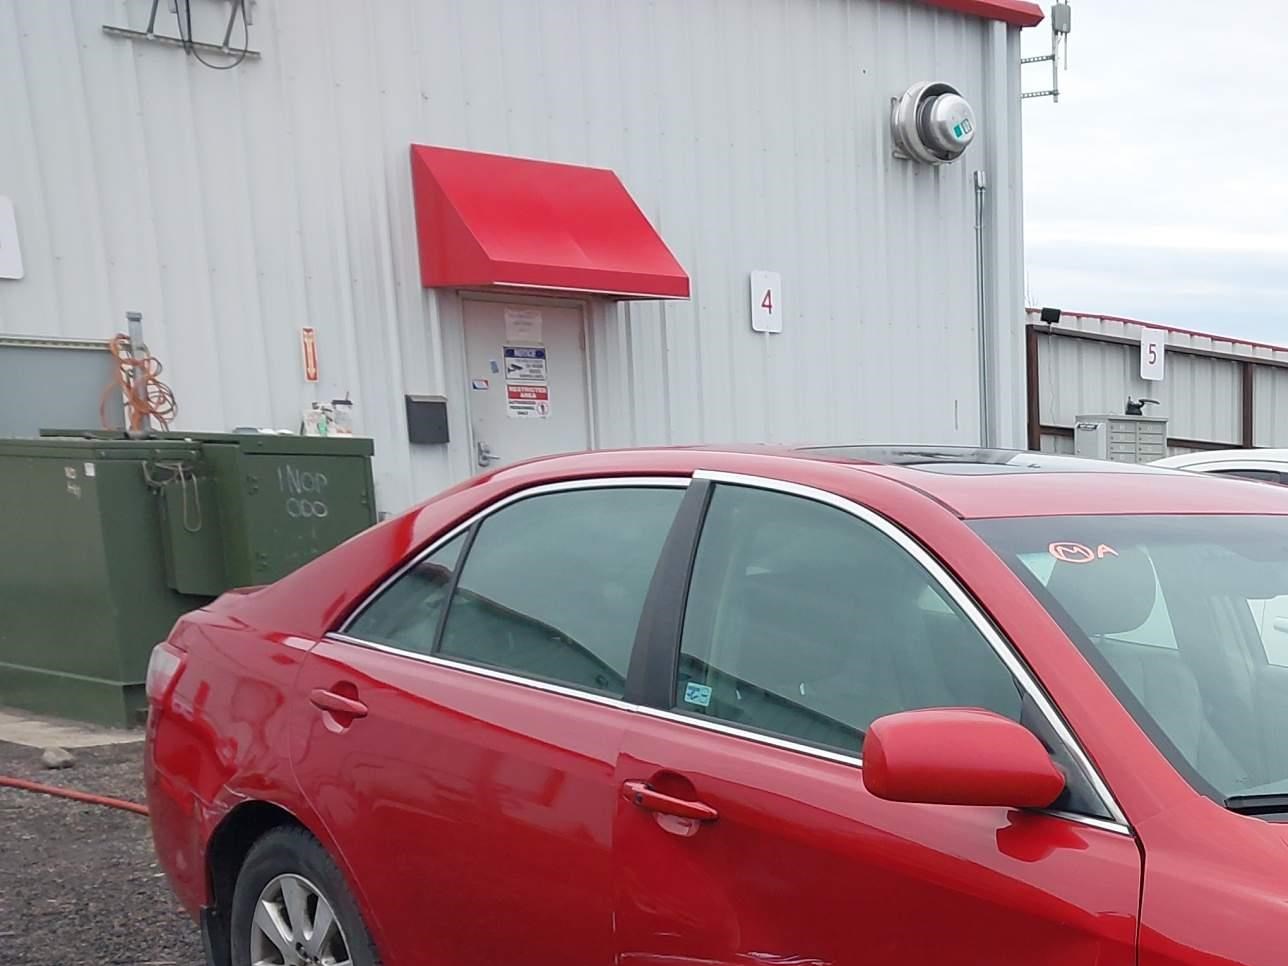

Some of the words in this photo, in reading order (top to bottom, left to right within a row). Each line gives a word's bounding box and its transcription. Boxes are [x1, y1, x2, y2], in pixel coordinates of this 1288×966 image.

[761, 289, 773, 315] 4
[1148, 343, 1157, 365] 5
[1097, 543, 1119, 558] A
